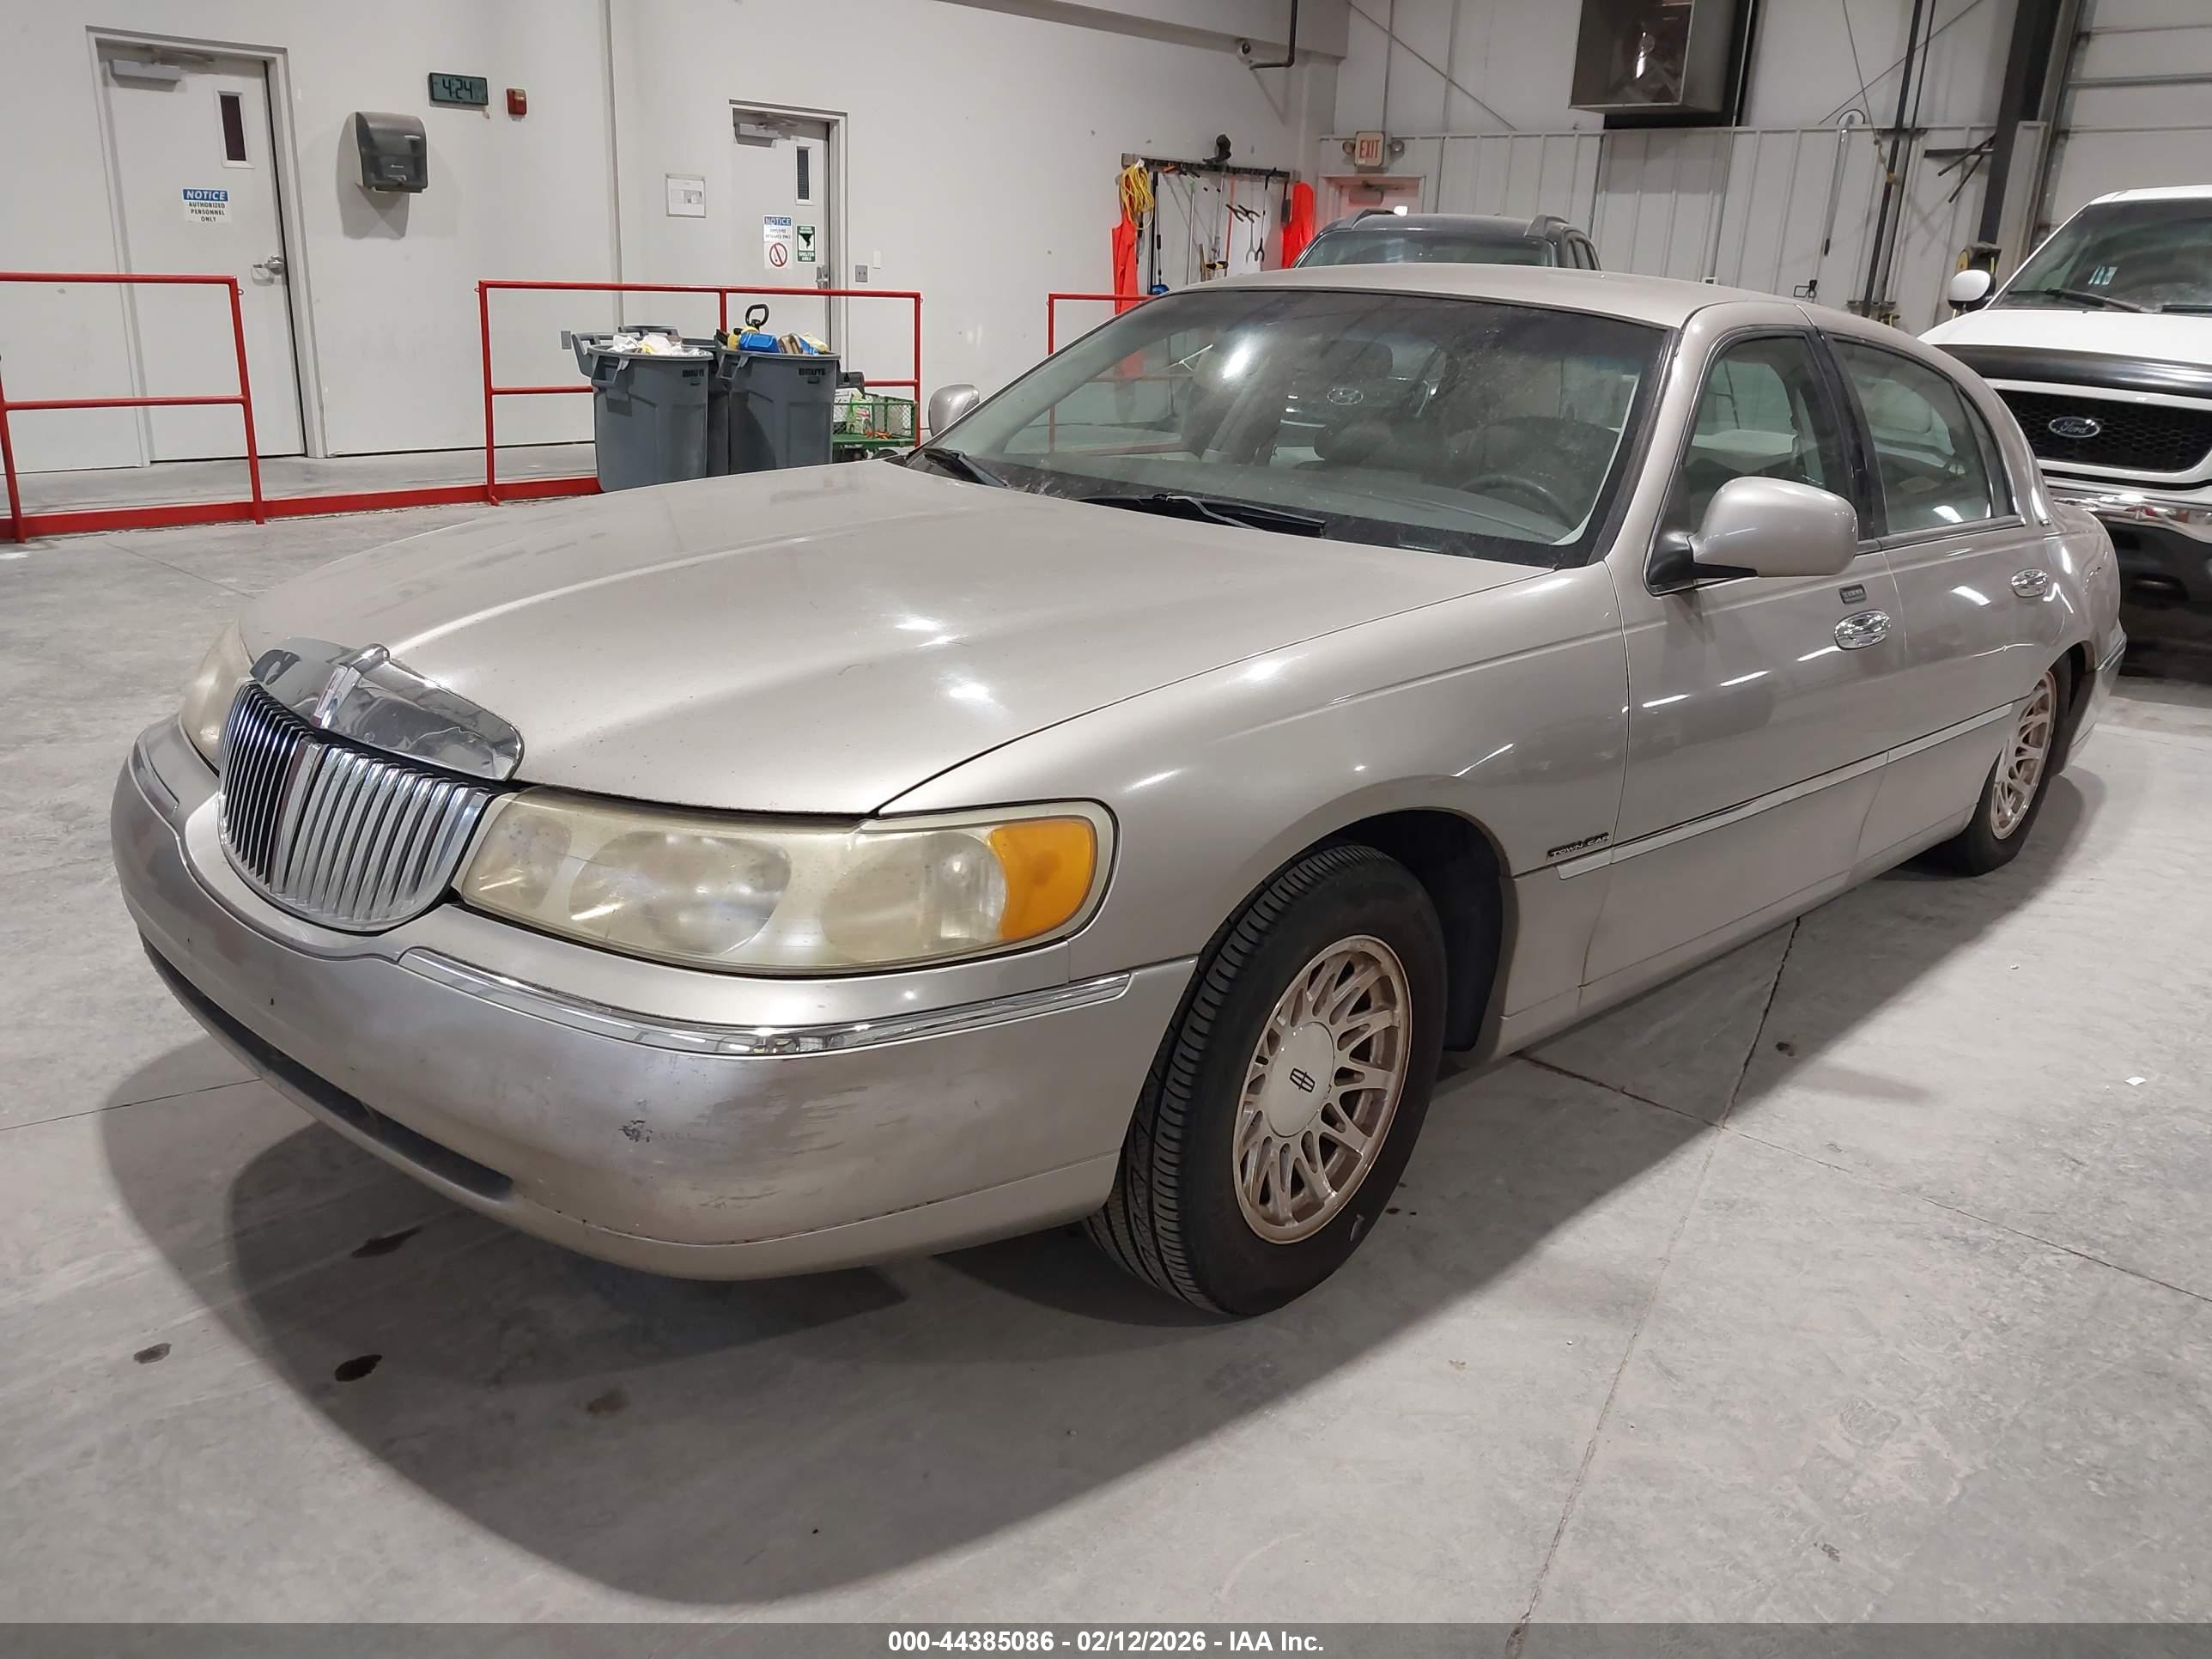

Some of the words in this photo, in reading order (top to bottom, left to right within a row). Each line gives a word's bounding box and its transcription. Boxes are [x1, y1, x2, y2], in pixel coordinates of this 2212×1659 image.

[441, 77, 474, 100] 4:24
[1359, 139, 1380, 159] EXIT
[186, 190, 226, 201] NOTICE
[765, 217, 791, 226] NOTICE
[2060, 421, 2090, 434] Ford
[1549, 842, 1584, 857] TOWN
[1586, 834, 1610, 847] CAR
